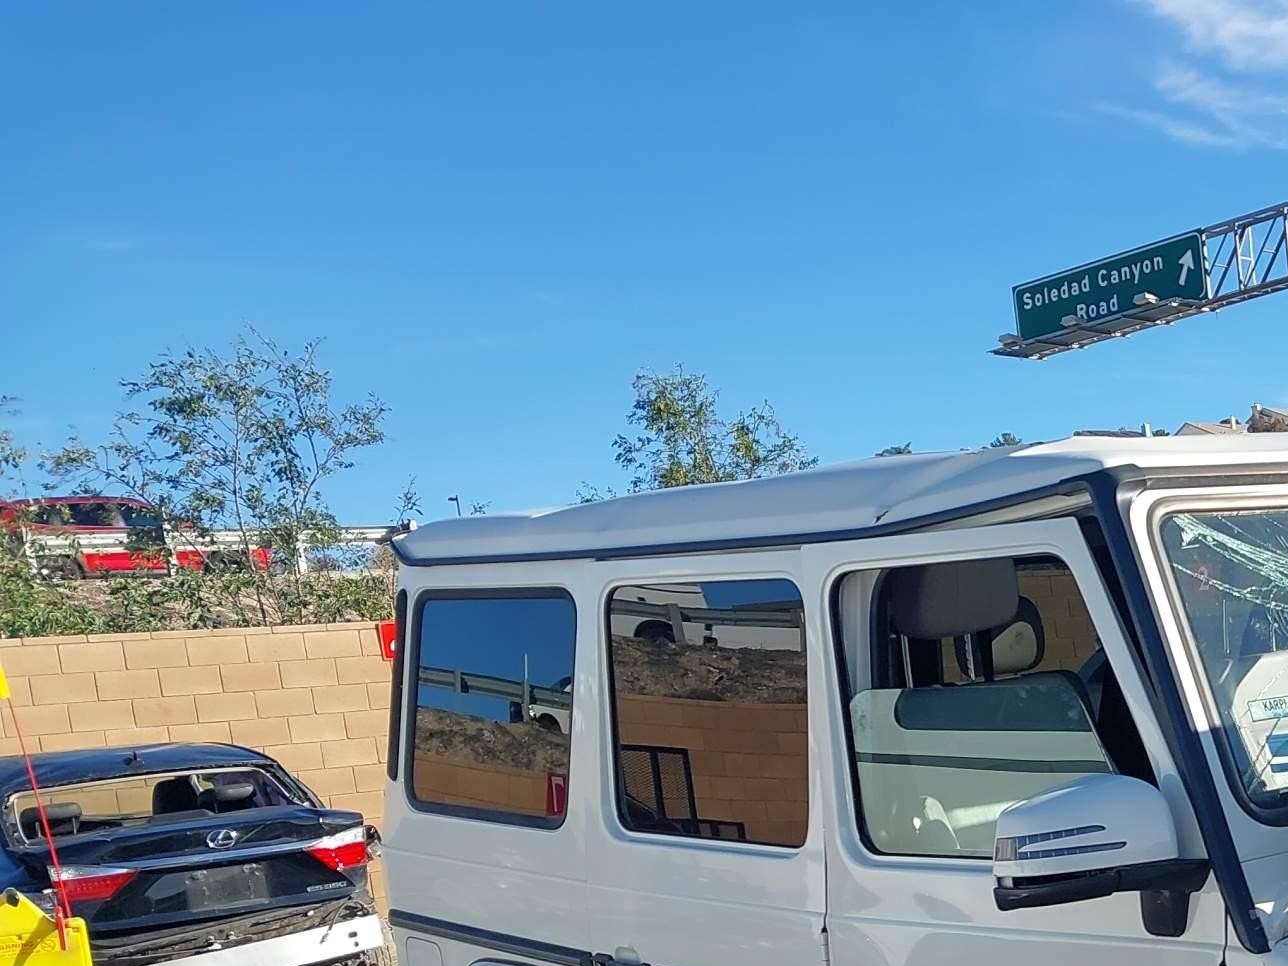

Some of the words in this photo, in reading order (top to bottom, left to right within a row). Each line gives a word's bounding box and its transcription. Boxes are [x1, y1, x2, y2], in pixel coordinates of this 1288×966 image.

[1022, 274, 1090, 310] Soledad
[1097, 255, 1164, 288] Canyon
[1075, 298, 1119, 321] Road
